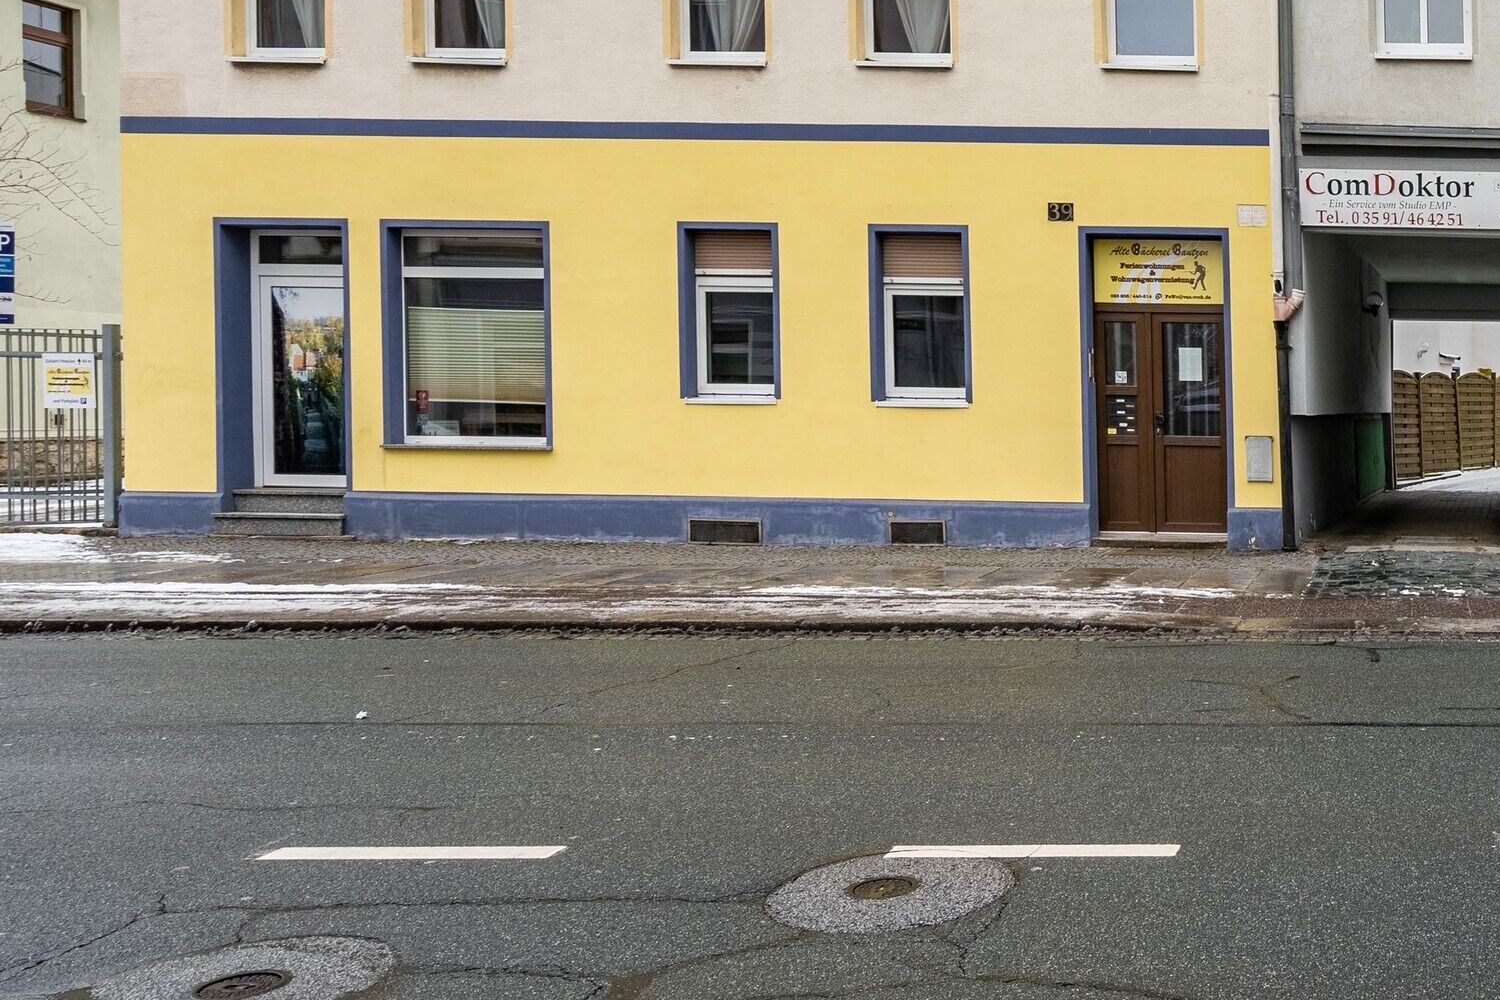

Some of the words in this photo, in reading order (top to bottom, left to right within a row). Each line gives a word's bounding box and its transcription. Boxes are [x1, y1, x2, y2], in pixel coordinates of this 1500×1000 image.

[1305, 171, 1475, 198] ComDoktor
[1048, 203, 1072, 220] 39
[1328, 199, 1343, 208] Ein
[1346, 200, 1376, 209] Service
[1399, 200, 1427, 210] Studio
[1428, 201, 1451, 210] EMP
[1315, 209, 1344, 224] Tel.
[1351, 212, 1359, 225] 0
[1363, 212, 1379, 225] 35
[1407, 212, 1424, 225] 46
[1427, 213, 1444, 226] 42
[1447, 213, 1464, 226] 51
[1109, 245, 1130, 256] Alte
[1131, 243, 1170, 257] Bäckerei
[1172, 243, 1208, 260] Bautzen
[1119, 262, 1185, 271] Ferienwohnungen
[1110, 275, 1195, 285] Wohnwagenvermietung
